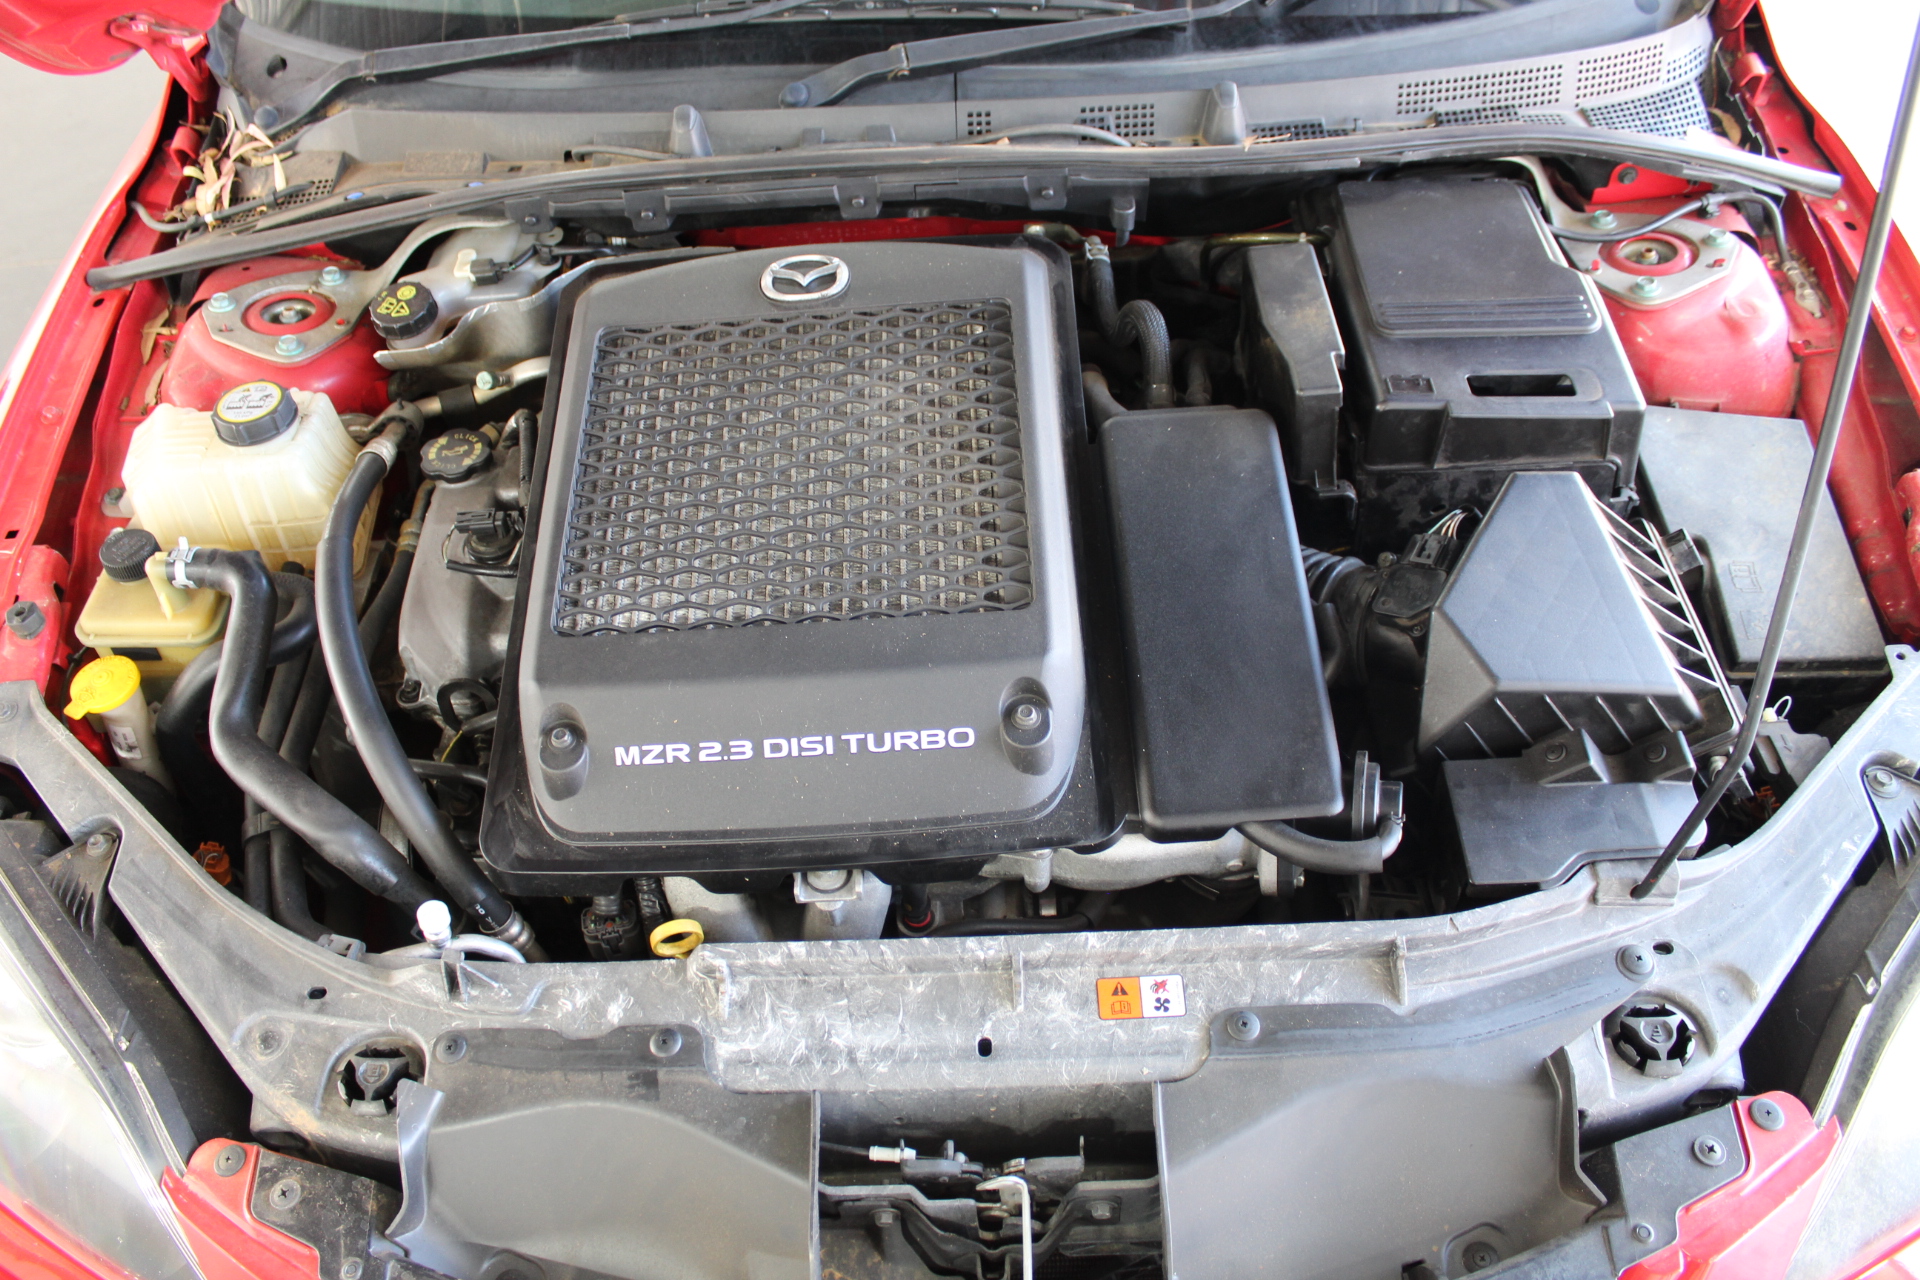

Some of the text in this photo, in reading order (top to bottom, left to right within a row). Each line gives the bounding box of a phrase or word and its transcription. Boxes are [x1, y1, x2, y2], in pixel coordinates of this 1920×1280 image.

[454, 433, 479, 443] CLICK
[614, 727, 975, 766] MZR 2.3 DISI TURBO
